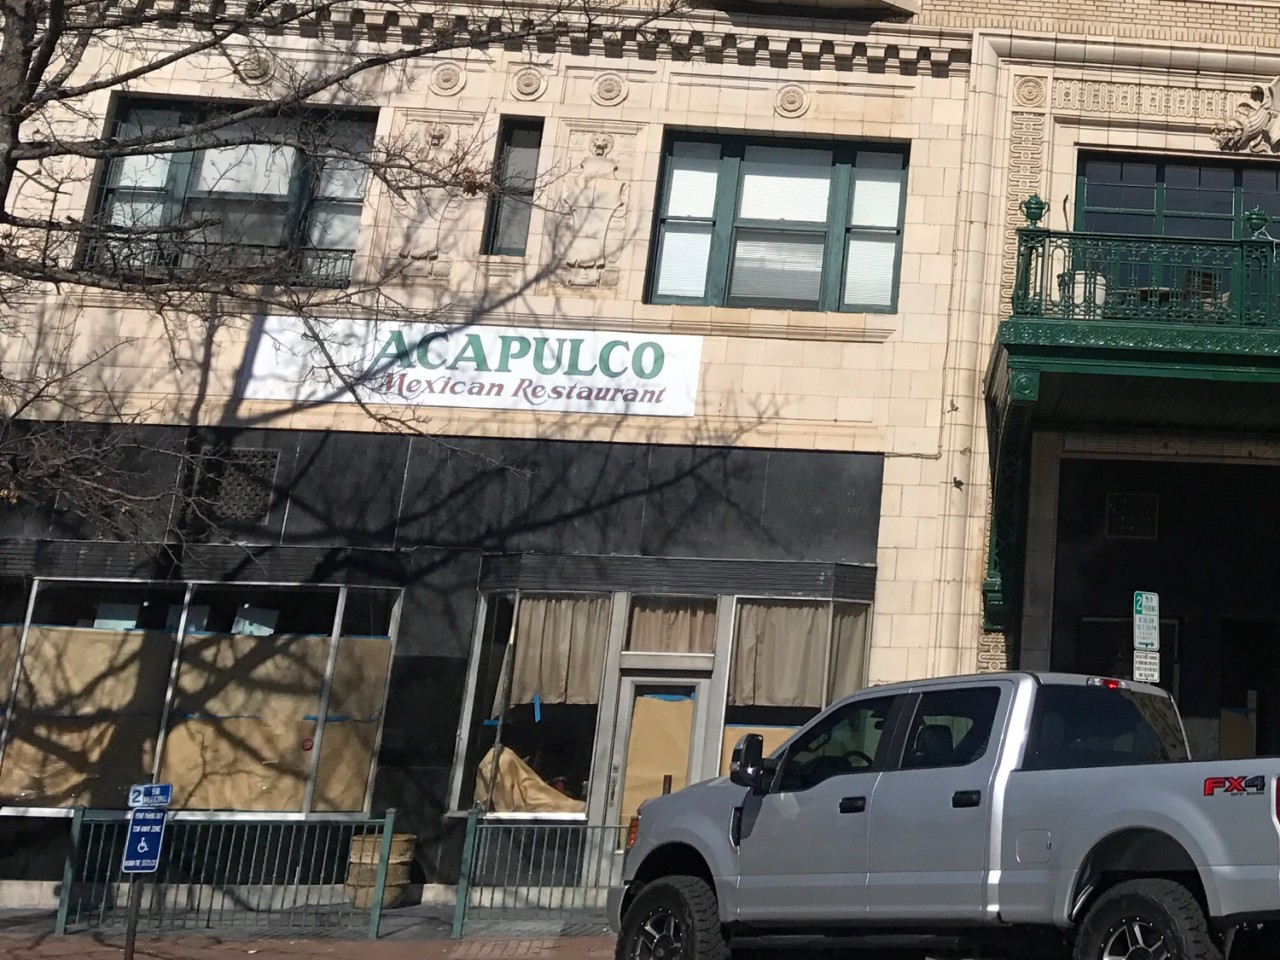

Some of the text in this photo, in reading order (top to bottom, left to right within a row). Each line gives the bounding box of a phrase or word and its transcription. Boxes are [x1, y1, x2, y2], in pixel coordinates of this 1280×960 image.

[365, 329, 665, 380] ACAPULCO
[382, 372, 667, 405] Mexican Restaurant
[1136, 596, 1142, 610] 2
[131, 789, 142, 803] 2
[1203, 775, 1266, 797] FX4
